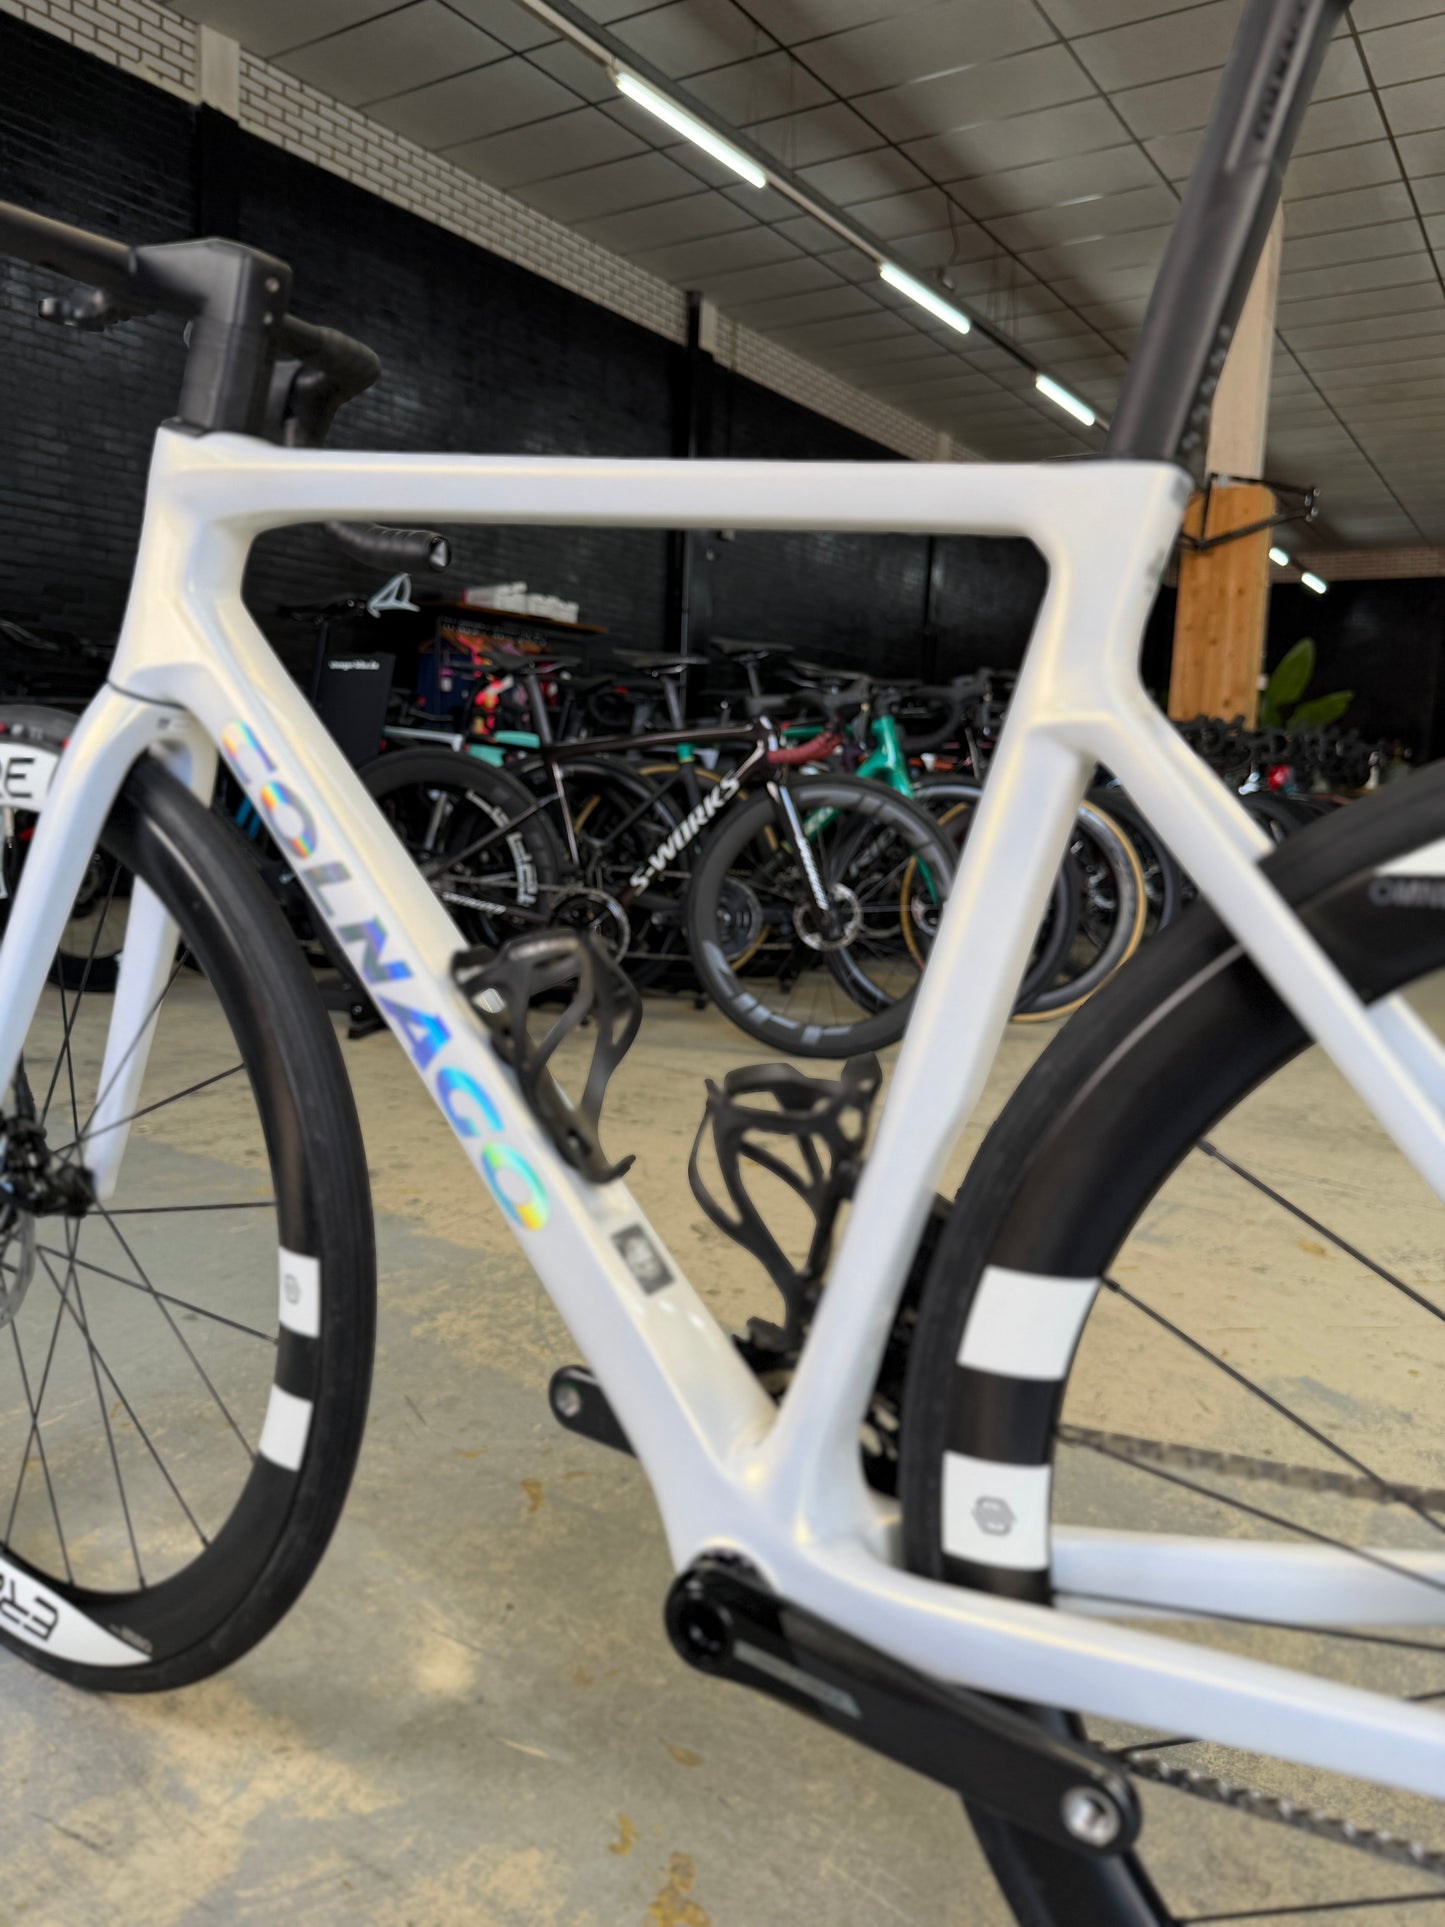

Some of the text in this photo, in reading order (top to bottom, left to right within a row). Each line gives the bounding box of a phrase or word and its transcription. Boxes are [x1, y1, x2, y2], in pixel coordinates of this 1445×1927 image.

[0, 756, 35, 799] E
[629, 769, 741, 896] S-WORKS
[221, 719, 549, 1232] COLNAGO
[0, 1572, 59, 1641] ER
